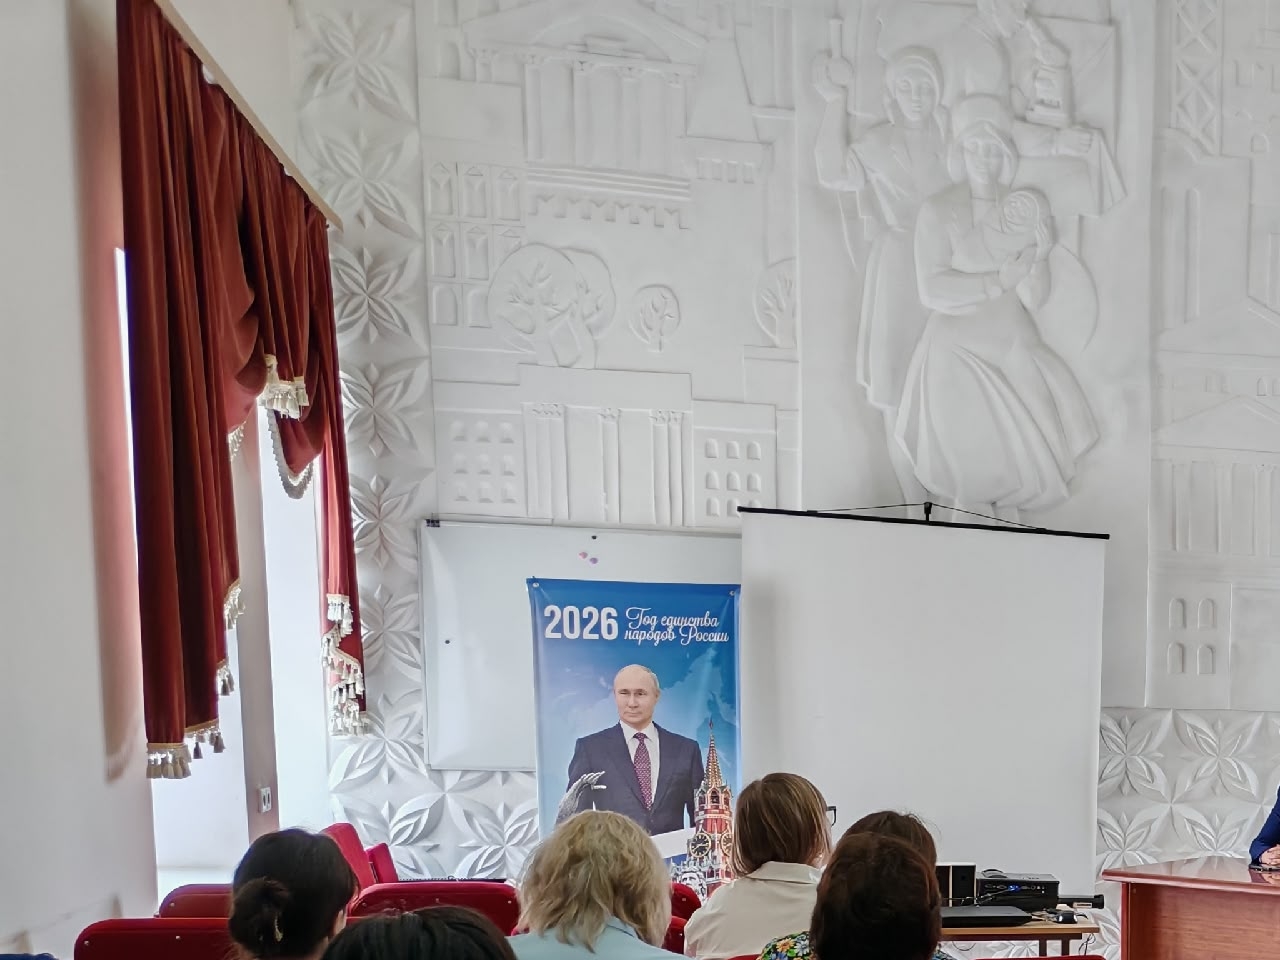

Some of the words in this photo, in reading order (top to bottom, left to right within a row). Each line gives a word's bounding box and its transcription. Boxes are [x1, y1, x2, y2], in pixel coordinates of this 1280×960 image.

[544, 605, 619, 640] 2026
[626, 607, 658, 630] Год
[660, 611, 719, 630] единства
[624, 627, 676, 646] народов
[680, 624, 729, 645] России
